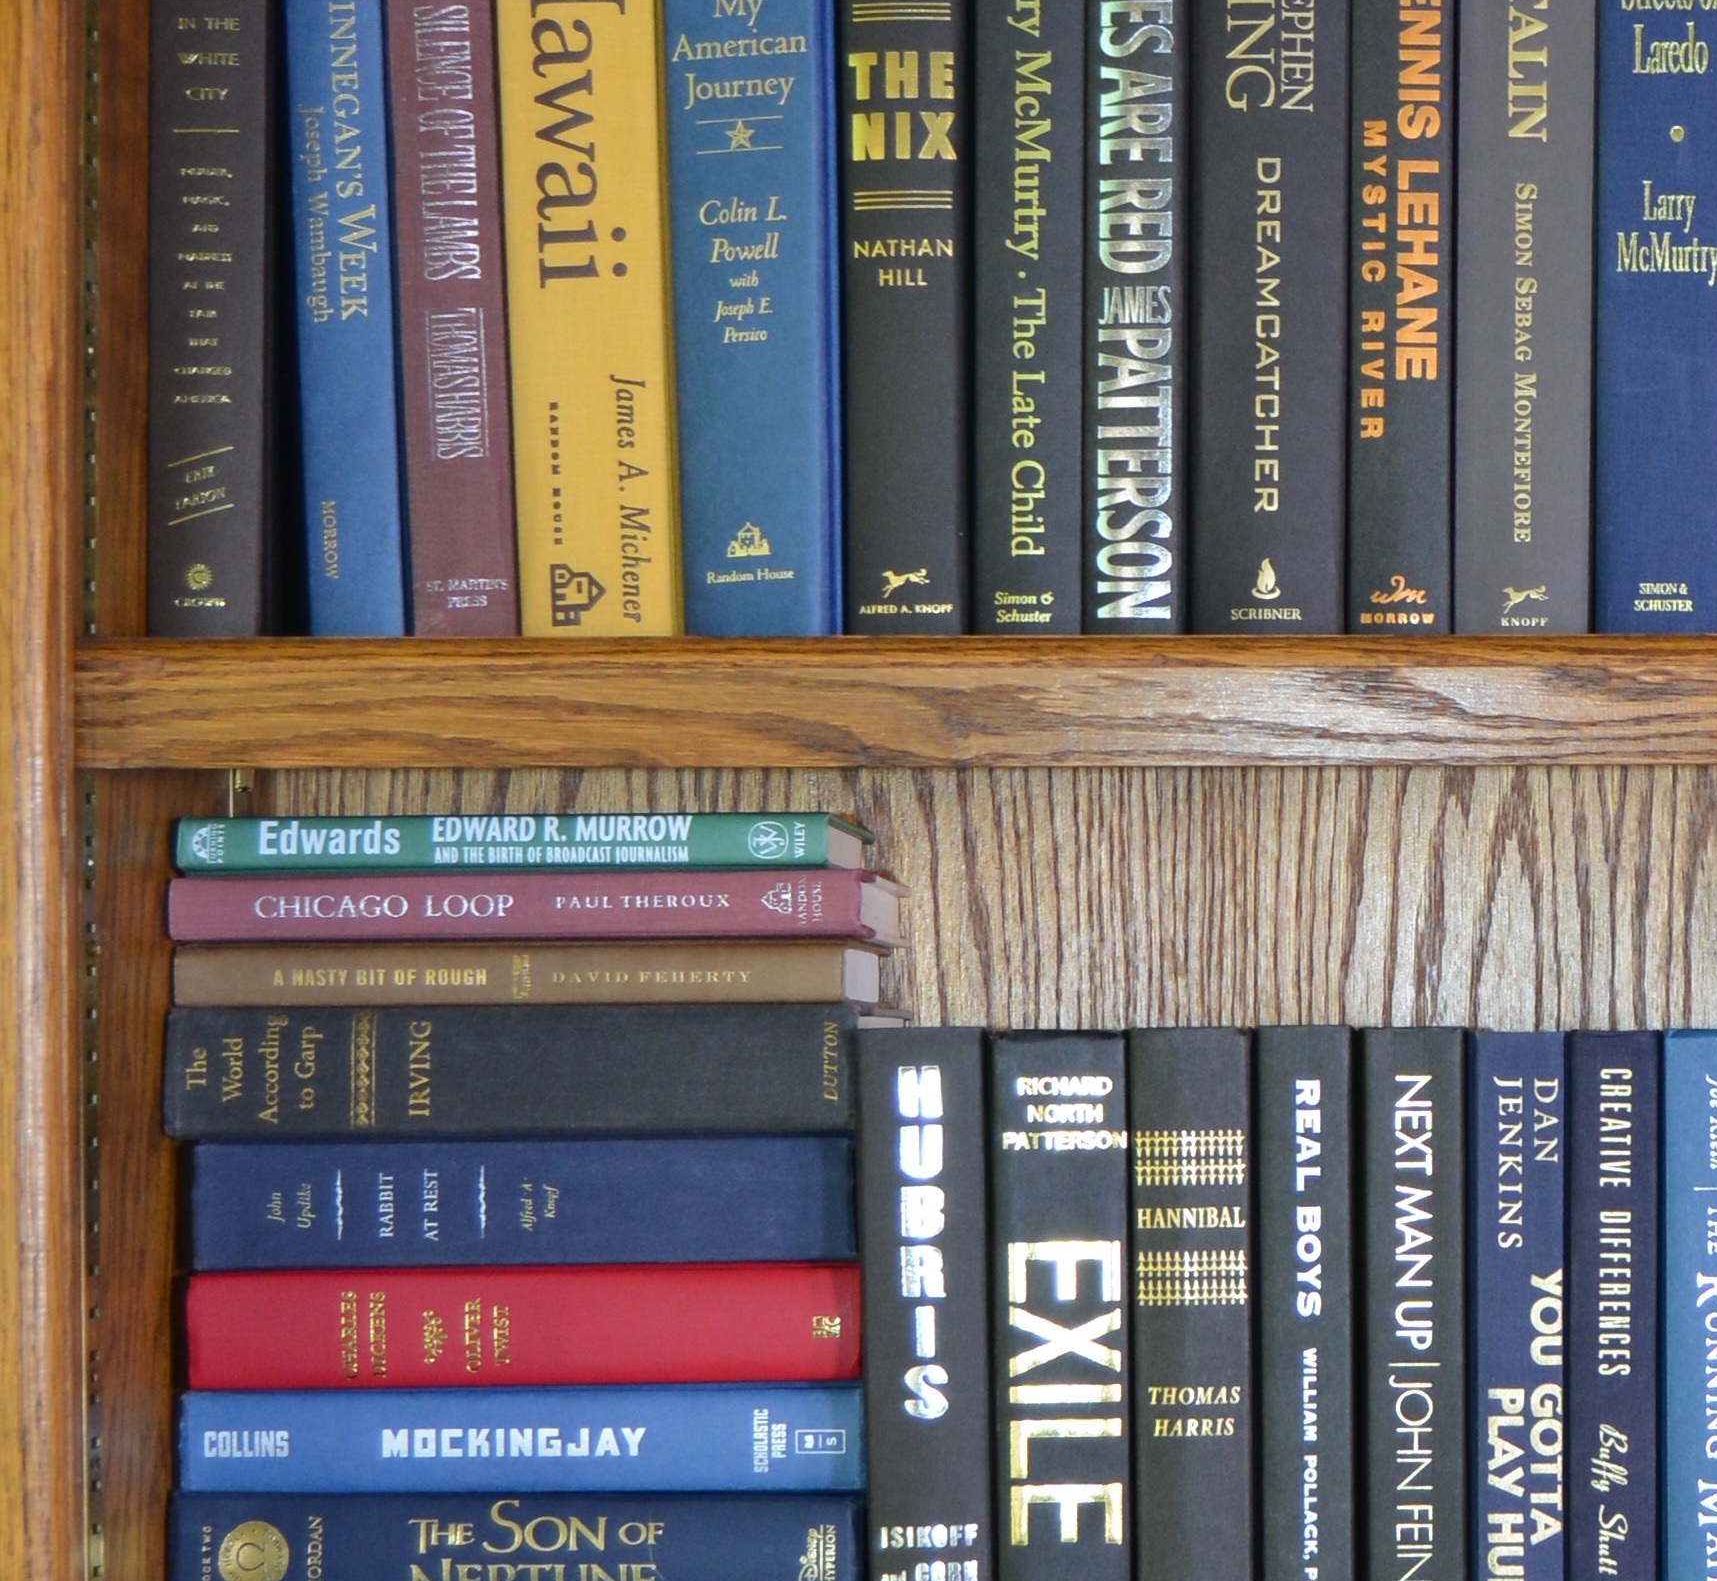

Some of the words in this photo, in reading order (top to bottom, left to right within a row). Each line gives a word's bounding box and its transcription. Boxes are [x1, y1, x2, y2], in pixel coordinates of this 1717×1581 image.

[672, 29, 807, 62] American
[1632, 21, 1709, 74] Laredo
[685, 72, 795, 110] Journey
[848, 51, 954, 100] THE
[852, 112, 957, 161] NIX
[1099, 66, 1173, 165] ARE
[1362, 120, 1387, 282] MYSTIC
[1642, 180, 1696, 233] Larry
[854, 239, 953, 258] NATHAN
[1099, 178, 1173, 274] RED
[879, 269, 927, 286] HILL
[1396, 160, 1439, 380] LEHANE
[1100, 285, 1172, 326] JAMES
[1254, 158, 1281, 512] DREAMCATCHER
[1361, 311, 1385, 438] RIVER
[610, 374, 645, 449] James
[618, 460, 649, 494] A.
[1096, 327, 1172, 619] PATTERSON
[620, 505, 651, 622] Michener
[707, 570, 754, 583] Random
[757, 568, 794, 580] House
[1232, 608, 1302, 620] SCRIBNER
[255, 895, 408, 918] CHICAGO
[425, 895, 513, 917] LOOP
[556, 895, 612, 910] PAUL
[620, 894, 729, 908] THEROUX
[409, 1022, 431, 1116] IRVING
[896, 1065, 948, 1419] HUBRIS
[1138, 1207, 1246, 1228] HANNIBAL
[1008, 1239, 1123, 1545] EXILE
[1148, 1386, 1240, 1405] THOMAS
[204, 1431, 288, 1457] COLLINS
[382, 1427, 646, 1457] MOCKINGJAY
[1154, 1418, 1234, 1436] HARRIS
